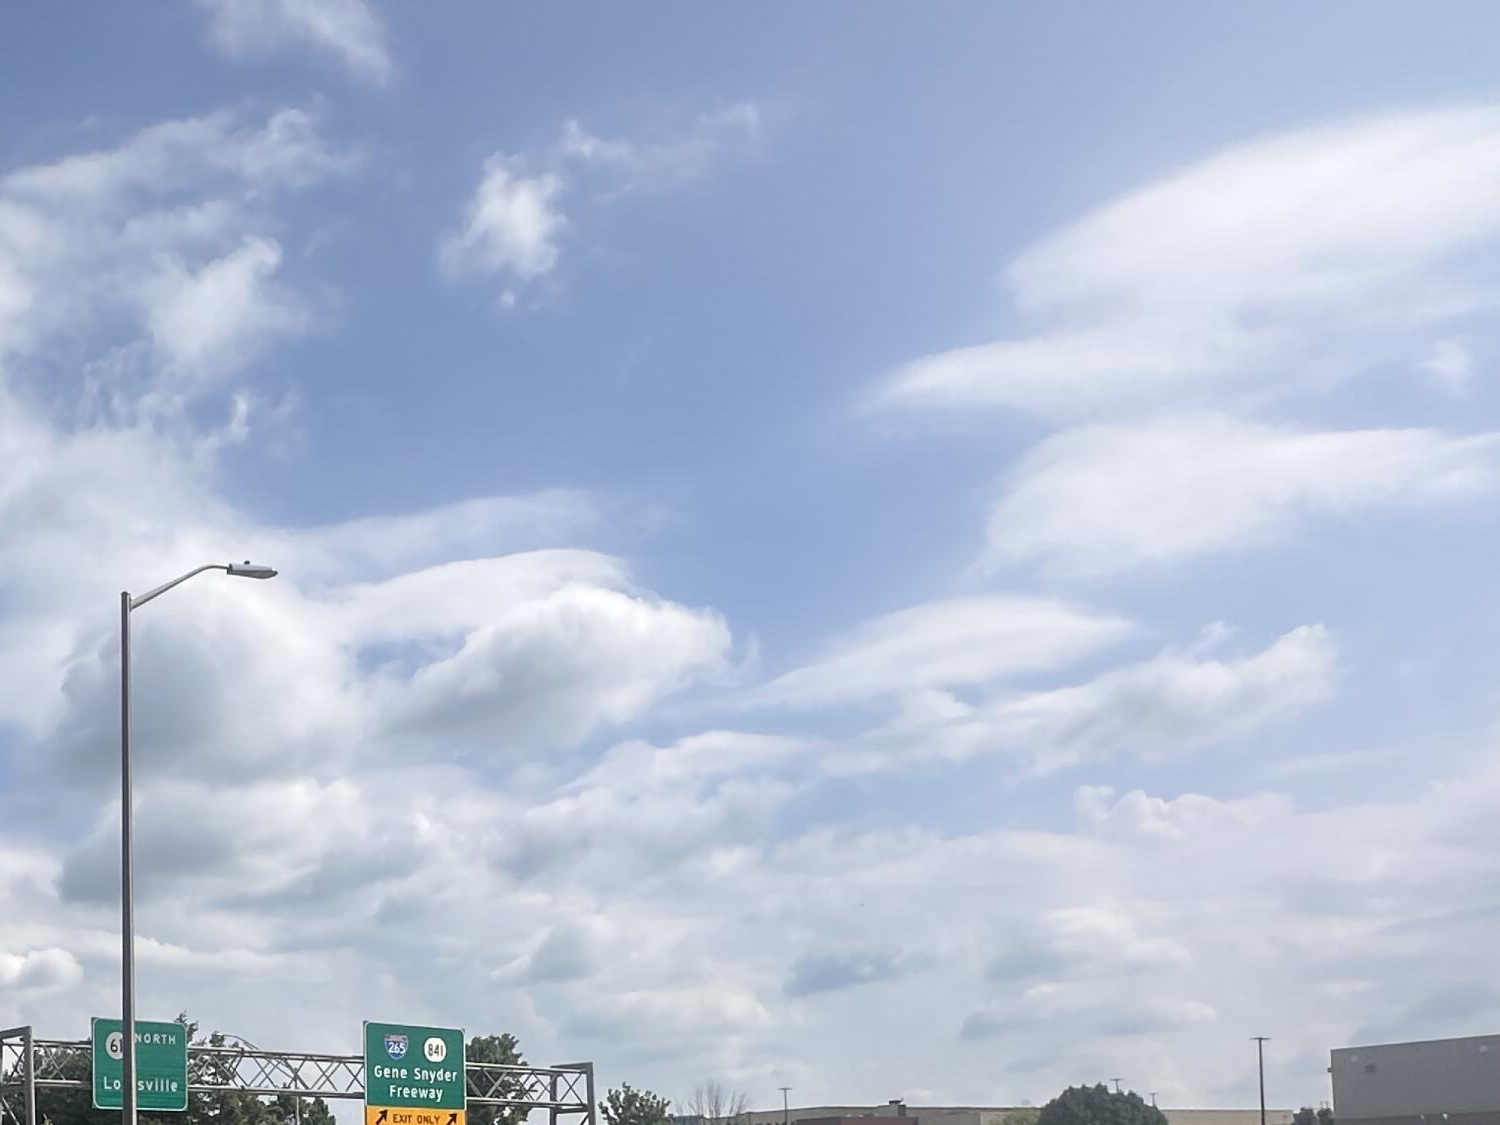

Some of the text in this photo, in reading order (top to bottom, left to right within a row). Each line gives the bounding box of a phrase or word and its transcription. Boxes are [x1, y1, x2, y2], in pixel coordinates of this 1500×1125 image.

[388, 1041, 406, 1054] 265
[427, 1043, 444, 1057] 841
[374, 1065, 458, 1084] Gene Snyder
[103, 1075, 178, 1092] Losville
[389, 1085, 443, 1103] Freeway
[392, 1113, 440, 1124] EXIT ONLY
